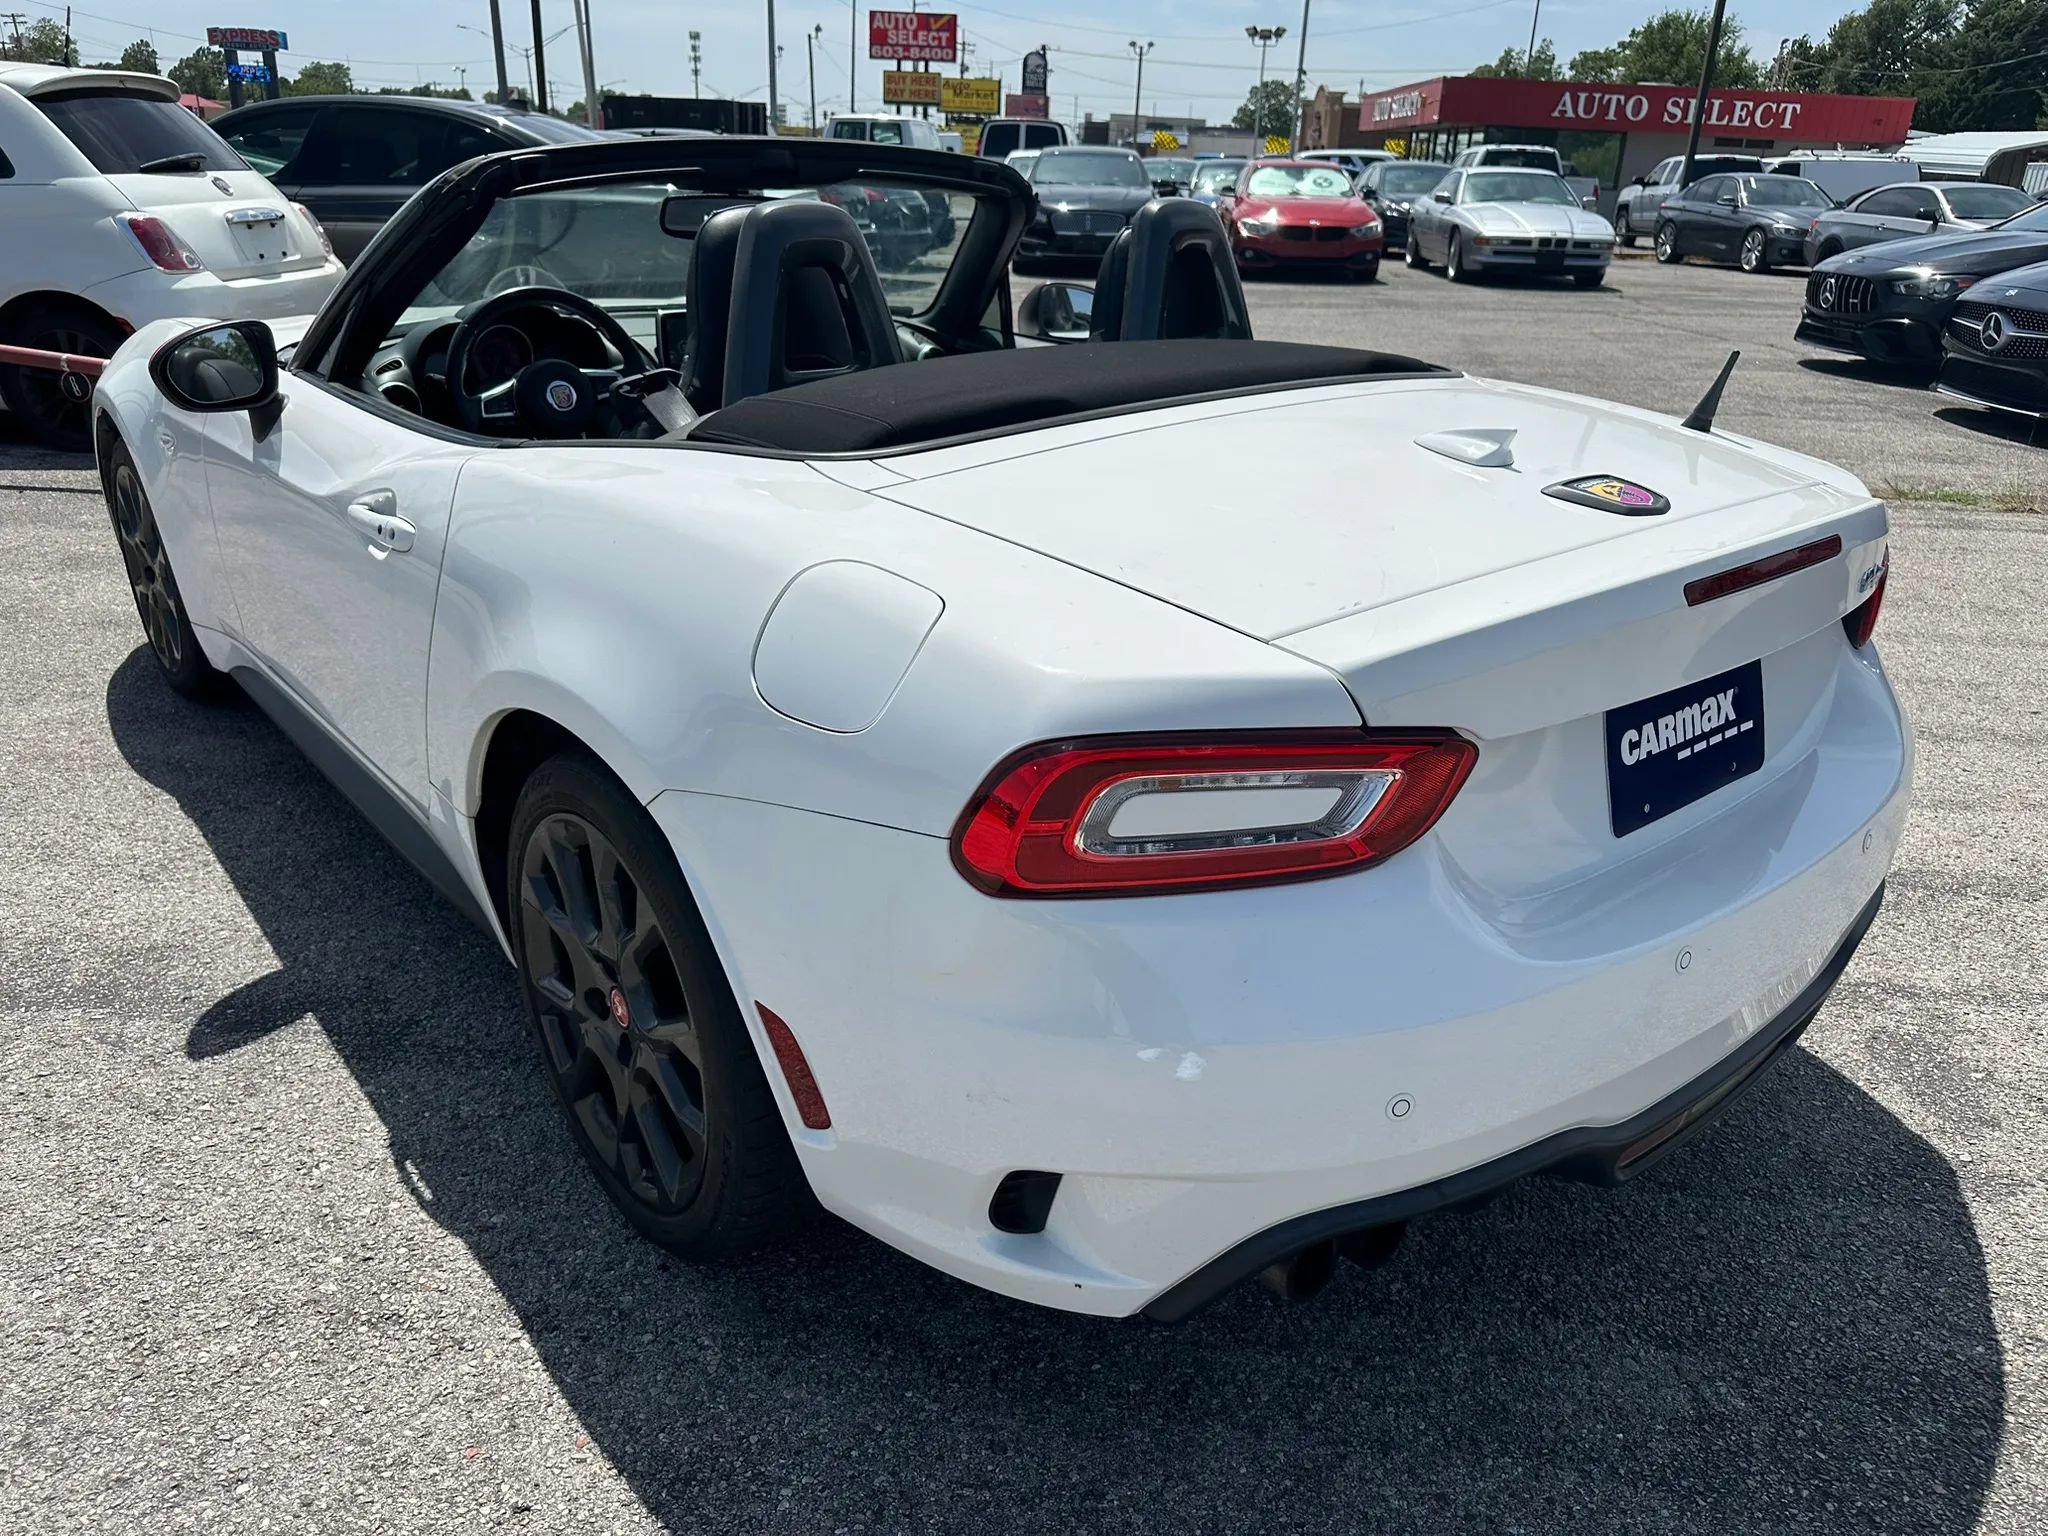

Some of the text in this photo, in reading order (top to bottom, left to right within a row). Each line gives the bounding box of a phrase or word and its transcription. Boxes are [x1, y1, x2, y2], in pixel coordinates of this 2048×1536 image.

[873, 13, 918, 31] AUTO
[206, 27, 280, 48] EXPRESS
[887, 30, 949, 46] SELECT
[871, 45, 954, 60] 603-8400
[886, 74, 937, 87] BUY HERE
[943, 80, 971, 90] Auto
[886, 87, 937, 99] PAY HERE
[952, 87, 994, 100] Market
[1551, 92, 1649, 121] AUTO
